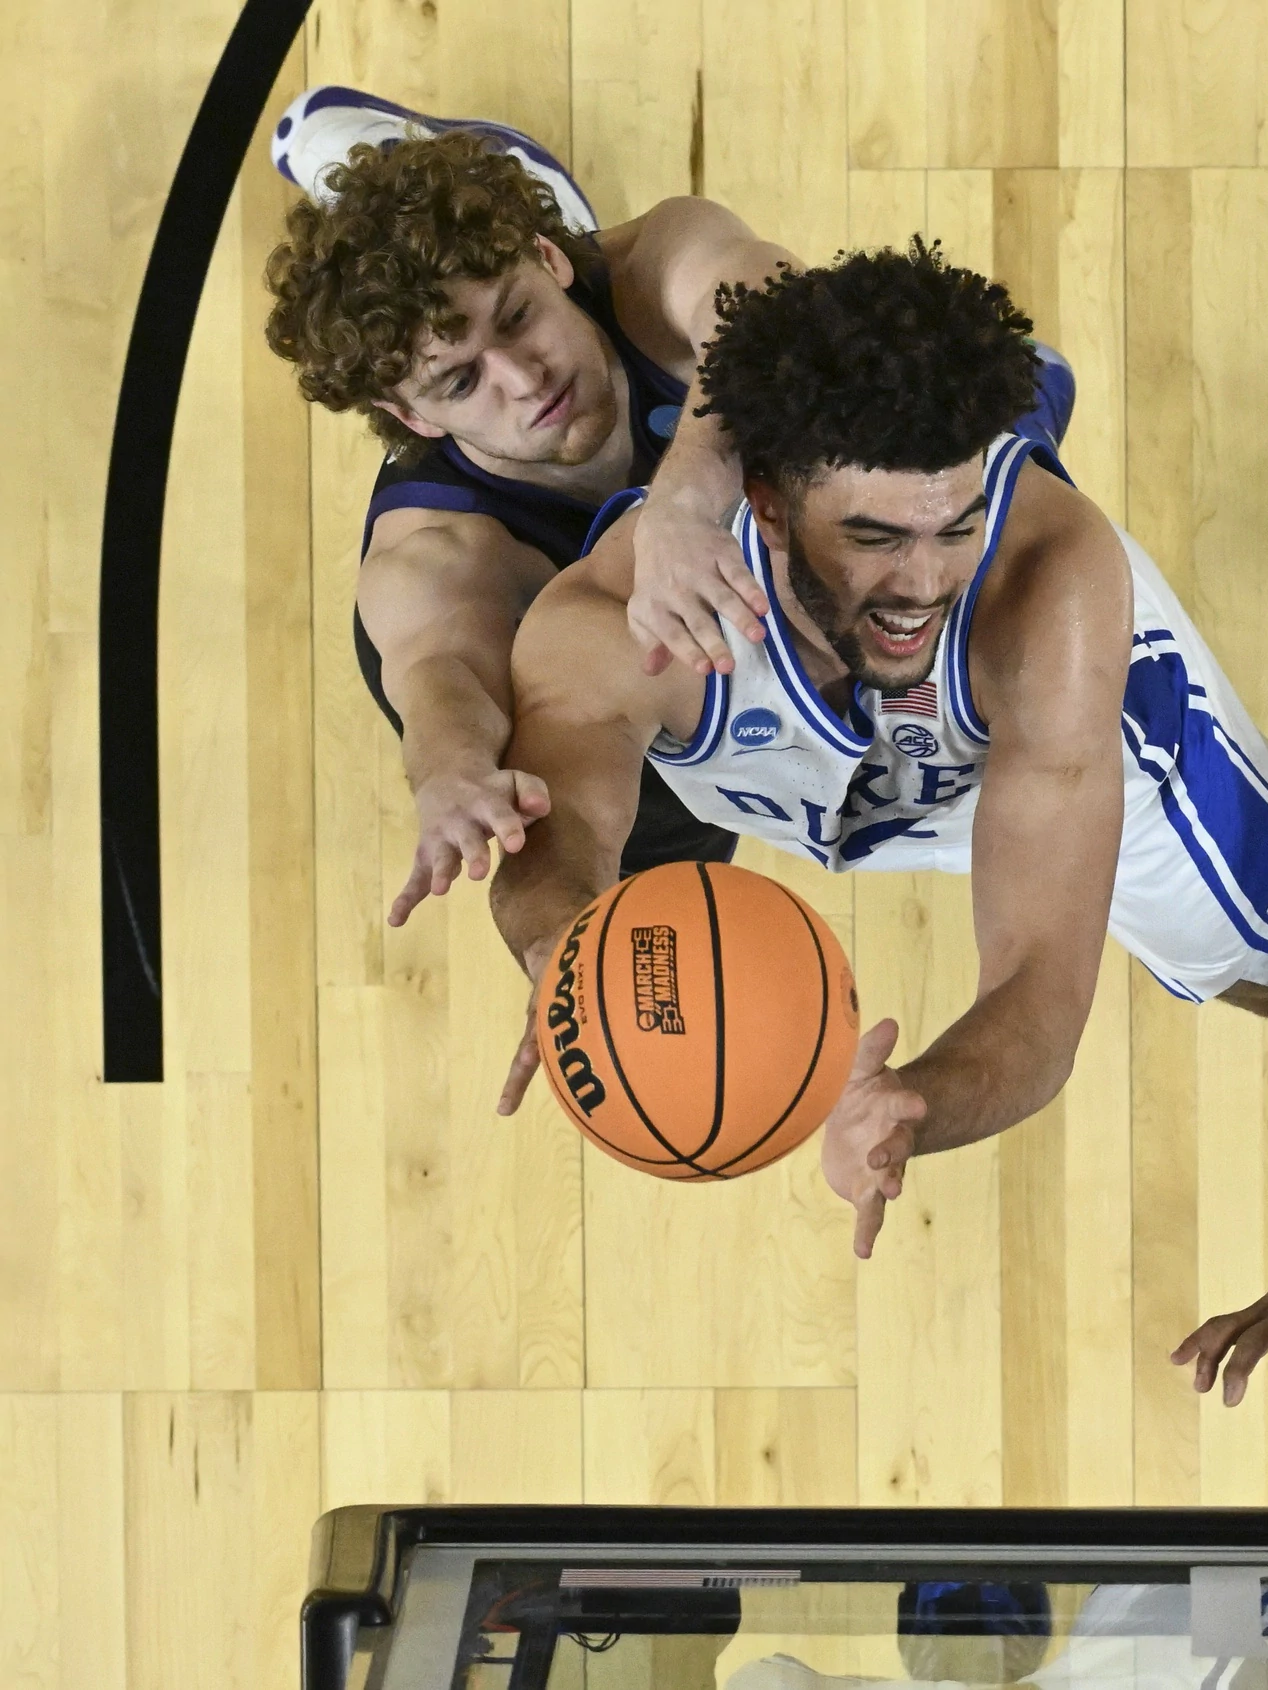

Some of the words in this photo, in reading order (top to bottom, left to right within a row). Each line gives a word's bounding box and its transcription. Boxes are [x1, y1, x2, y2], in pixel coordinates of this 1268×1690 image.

[737, 726, 777, 738] NCAA
[895, 735, 934, 747] ACC
[716, 761, 975, 847] DUKE
[577, 962, 585, 991] NXT
[635, 953, 654, 1011] MARCH
[653, 926, 672, 1002] MADNESS
[548, 903, 606, 1118] Wilson
[578, 995, 588, 1025] EVO
